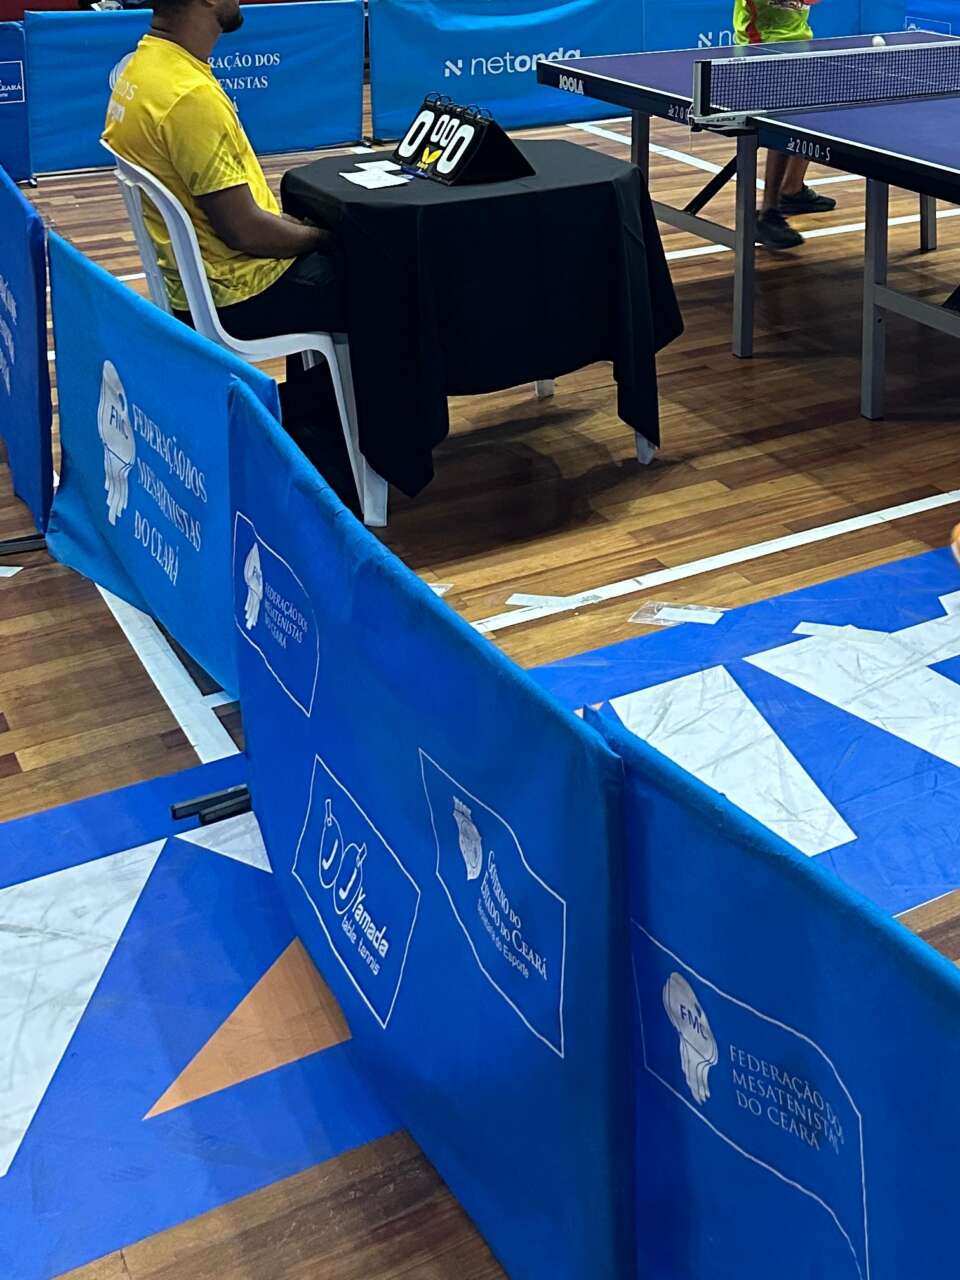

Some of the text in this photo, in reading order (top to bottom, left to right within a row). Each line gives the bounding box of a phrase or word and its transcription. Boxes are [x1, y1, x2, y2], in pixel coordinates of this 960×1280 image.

[255, 53, 281, 67] DOS
[559, 74, 584, 95] JOOLA
[134, 510, 179, 587] DO CEARÁ
[352, 887, 390, 959] Yamada
[357, 937, 381, 976] tennis
[512, 929, 548, 981] CEARÁ
[680, 1004, 709, 1040] FMC
[730, 1043, 825, 1111] FEDERAÇÃO
[736, 1089, 820, 1152] DO CEARÁ
